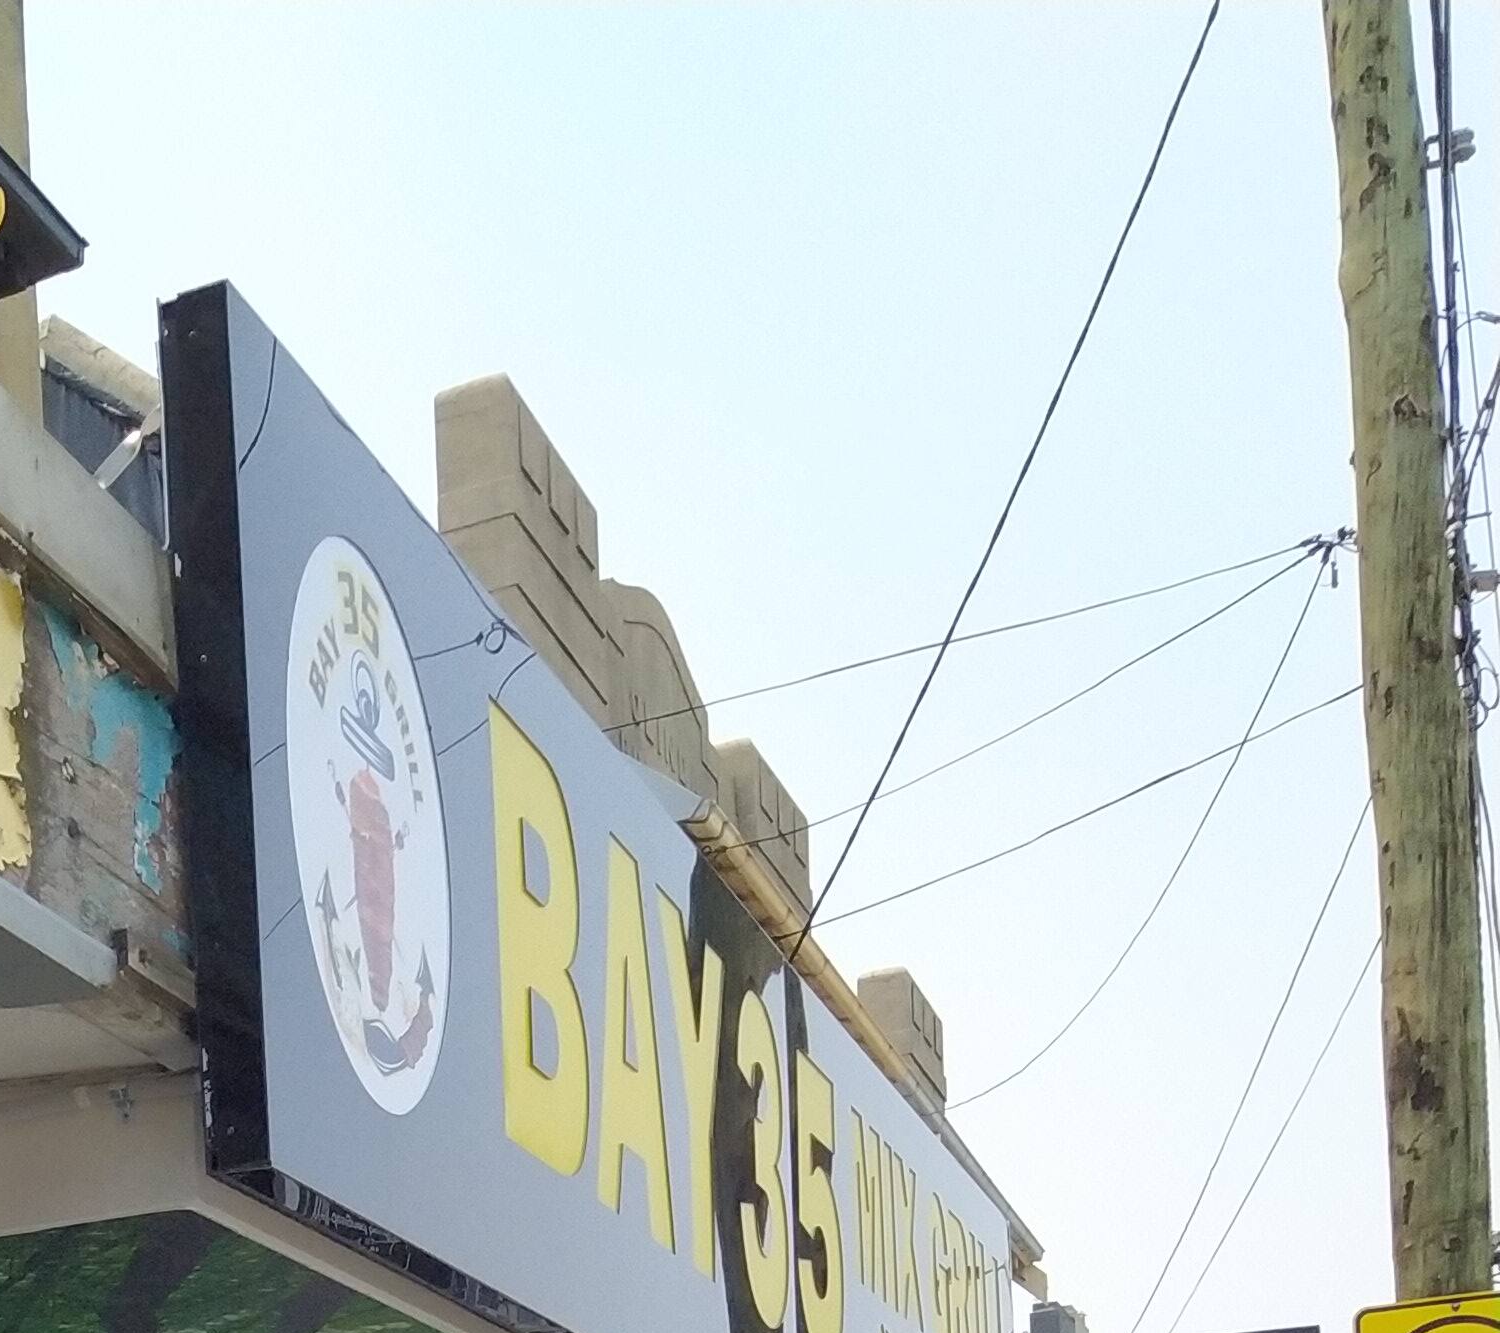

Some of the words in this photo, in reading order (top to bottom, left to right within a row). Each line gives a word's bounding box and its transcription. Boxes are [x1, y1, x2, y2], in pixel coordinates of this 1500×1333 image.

[308, 616, 341, 709] BAY
[336, 570, 380, 661] 35
[488, 695, 725, 1283] BAY
[849, 1104, 925, 1333] MIX
